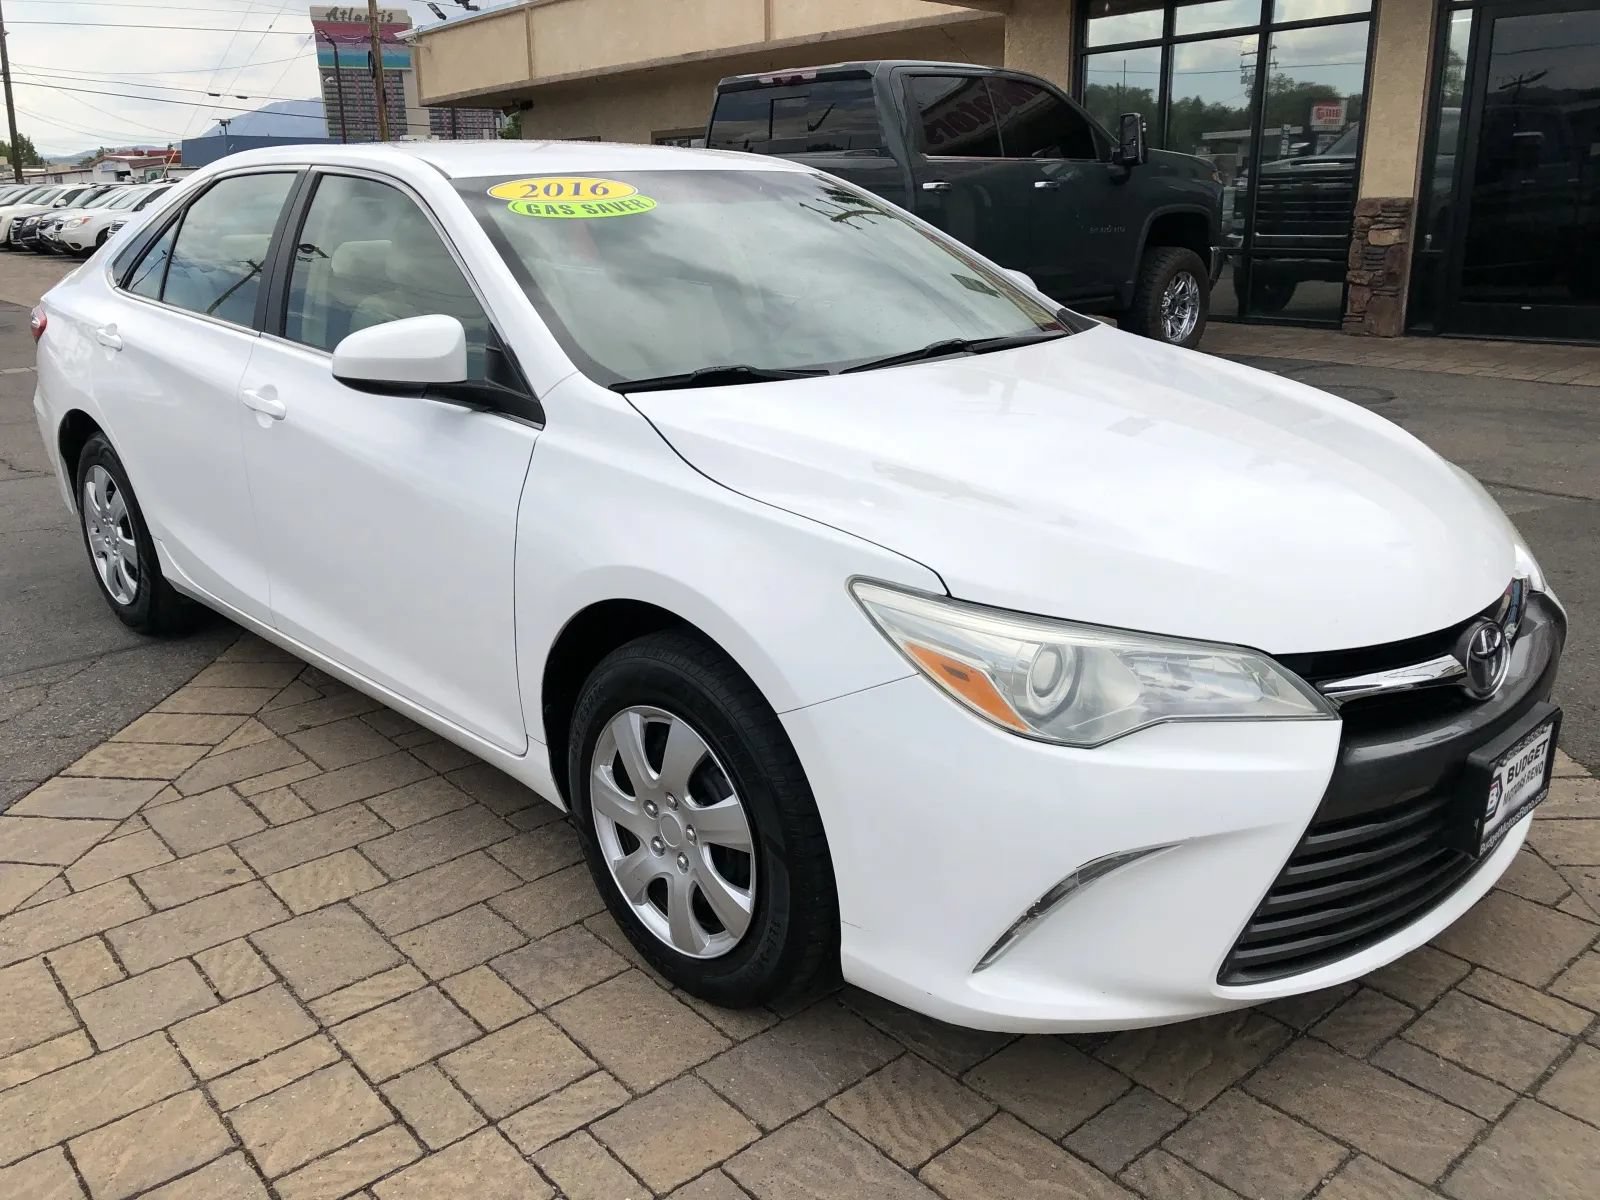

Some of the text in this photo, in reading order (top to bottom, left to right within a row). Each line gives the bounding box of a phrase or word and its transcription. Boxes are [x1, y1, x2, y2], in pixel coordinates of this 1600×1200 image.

[520, 181, 609, 198] 2016
[526, 199, 649, 215] GAS SAVER
[1506, 738, 1549, 784] BUDGET
